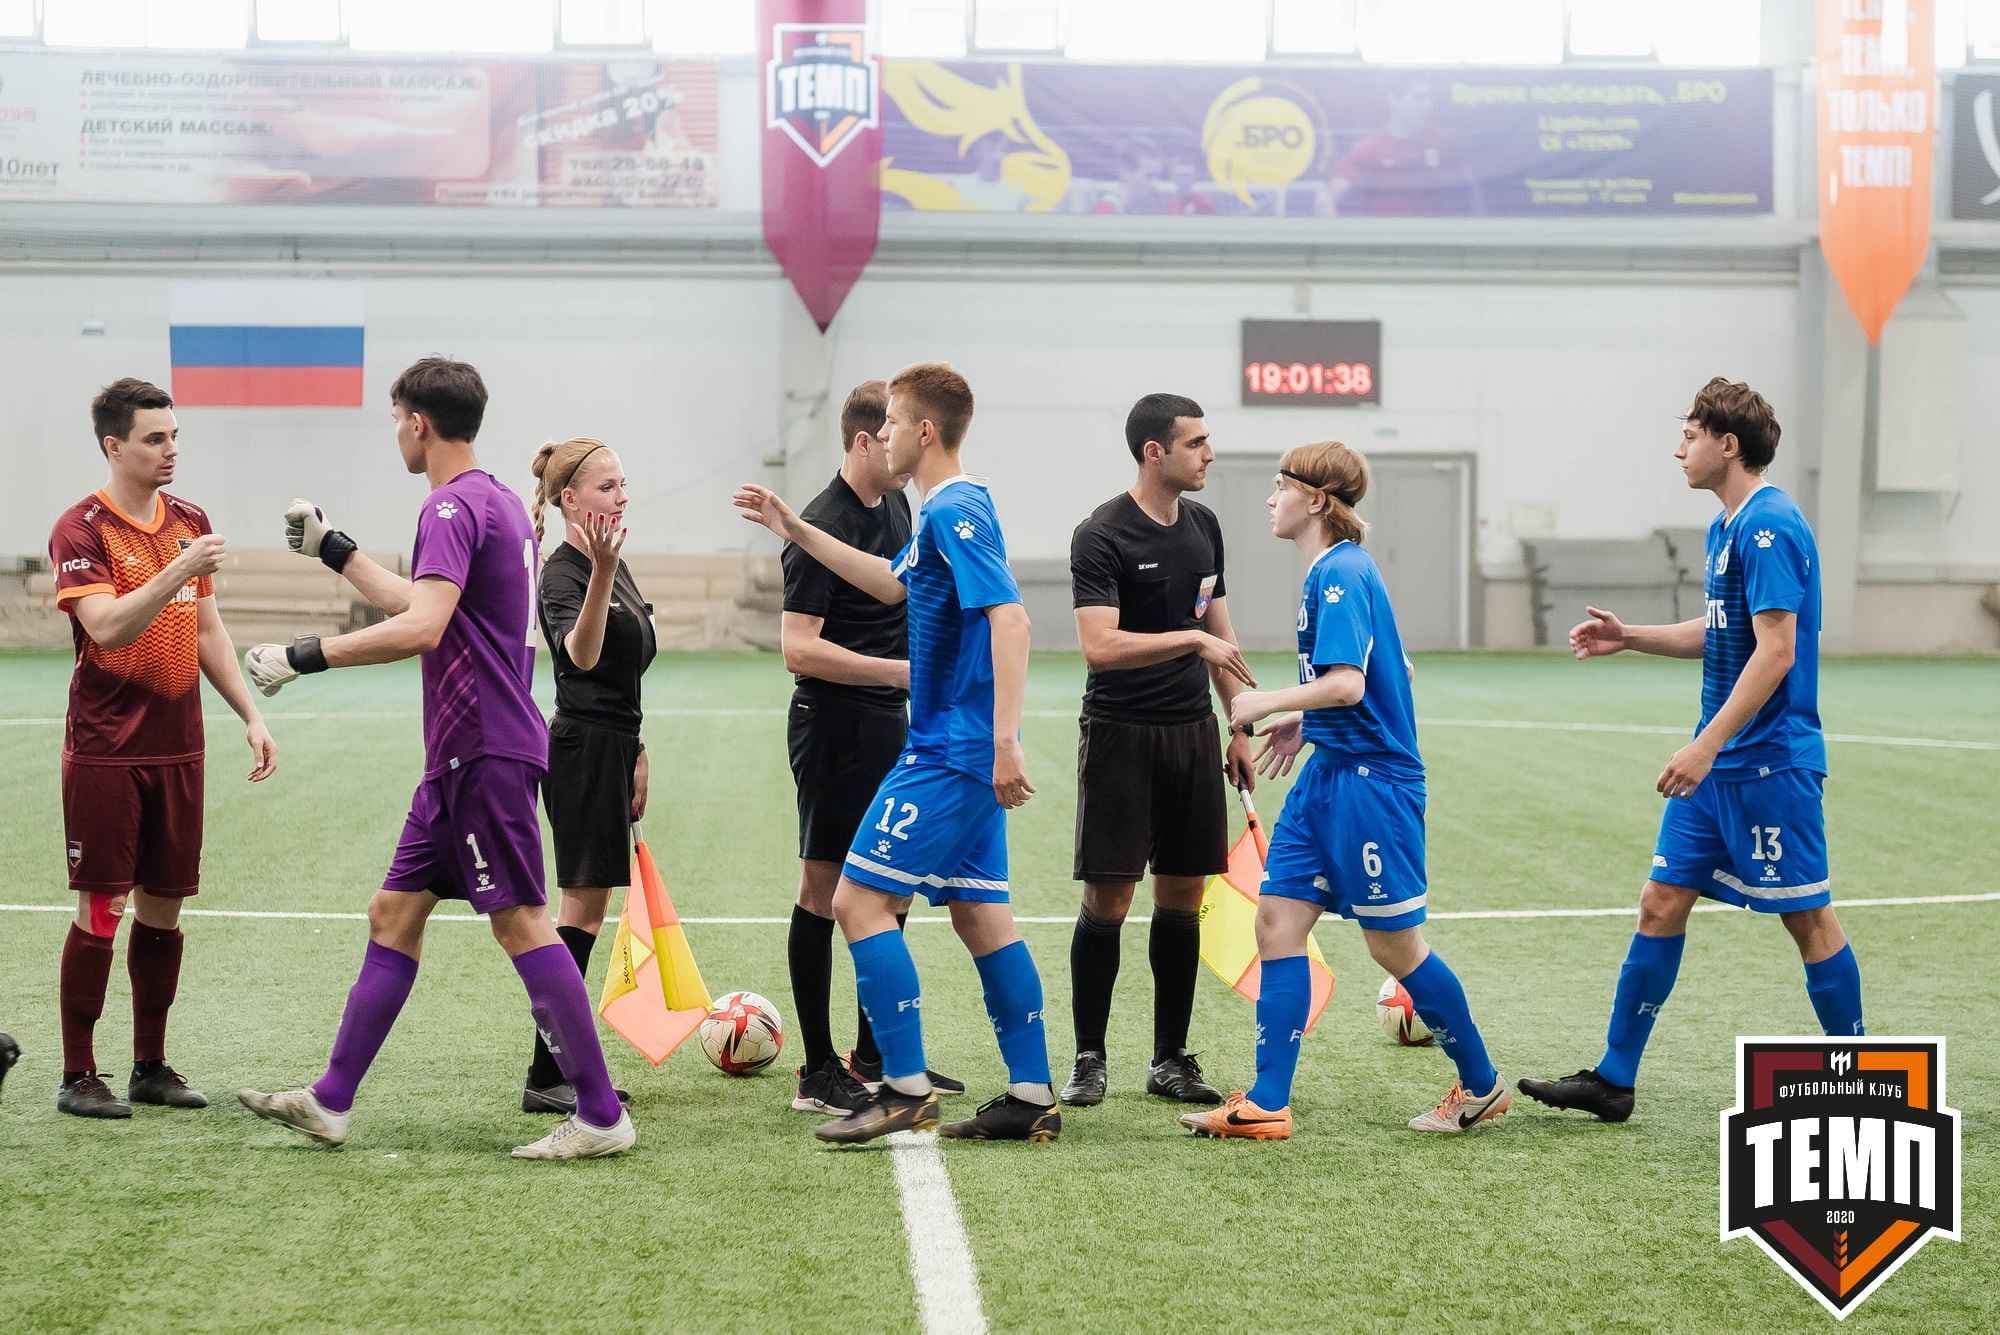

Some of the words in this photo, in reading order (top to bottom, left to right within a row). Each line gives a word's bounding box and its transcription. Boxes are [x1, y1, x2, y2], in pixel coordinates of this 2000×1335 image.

[777, 64, 867, 113] ТЕМП
[80, 117, 172, 135] ДЕТСКИЙ
[1826, 89, 1925, 133] ТОЛЬКО
[1246, 362, 1373, 395] 19:01:38
[875, 797, 919, 841] 12
[466, 833, 488, 869] 1
[1362, 841, 1383, 878] 6
[1751, 825, 1783, 861] 13
